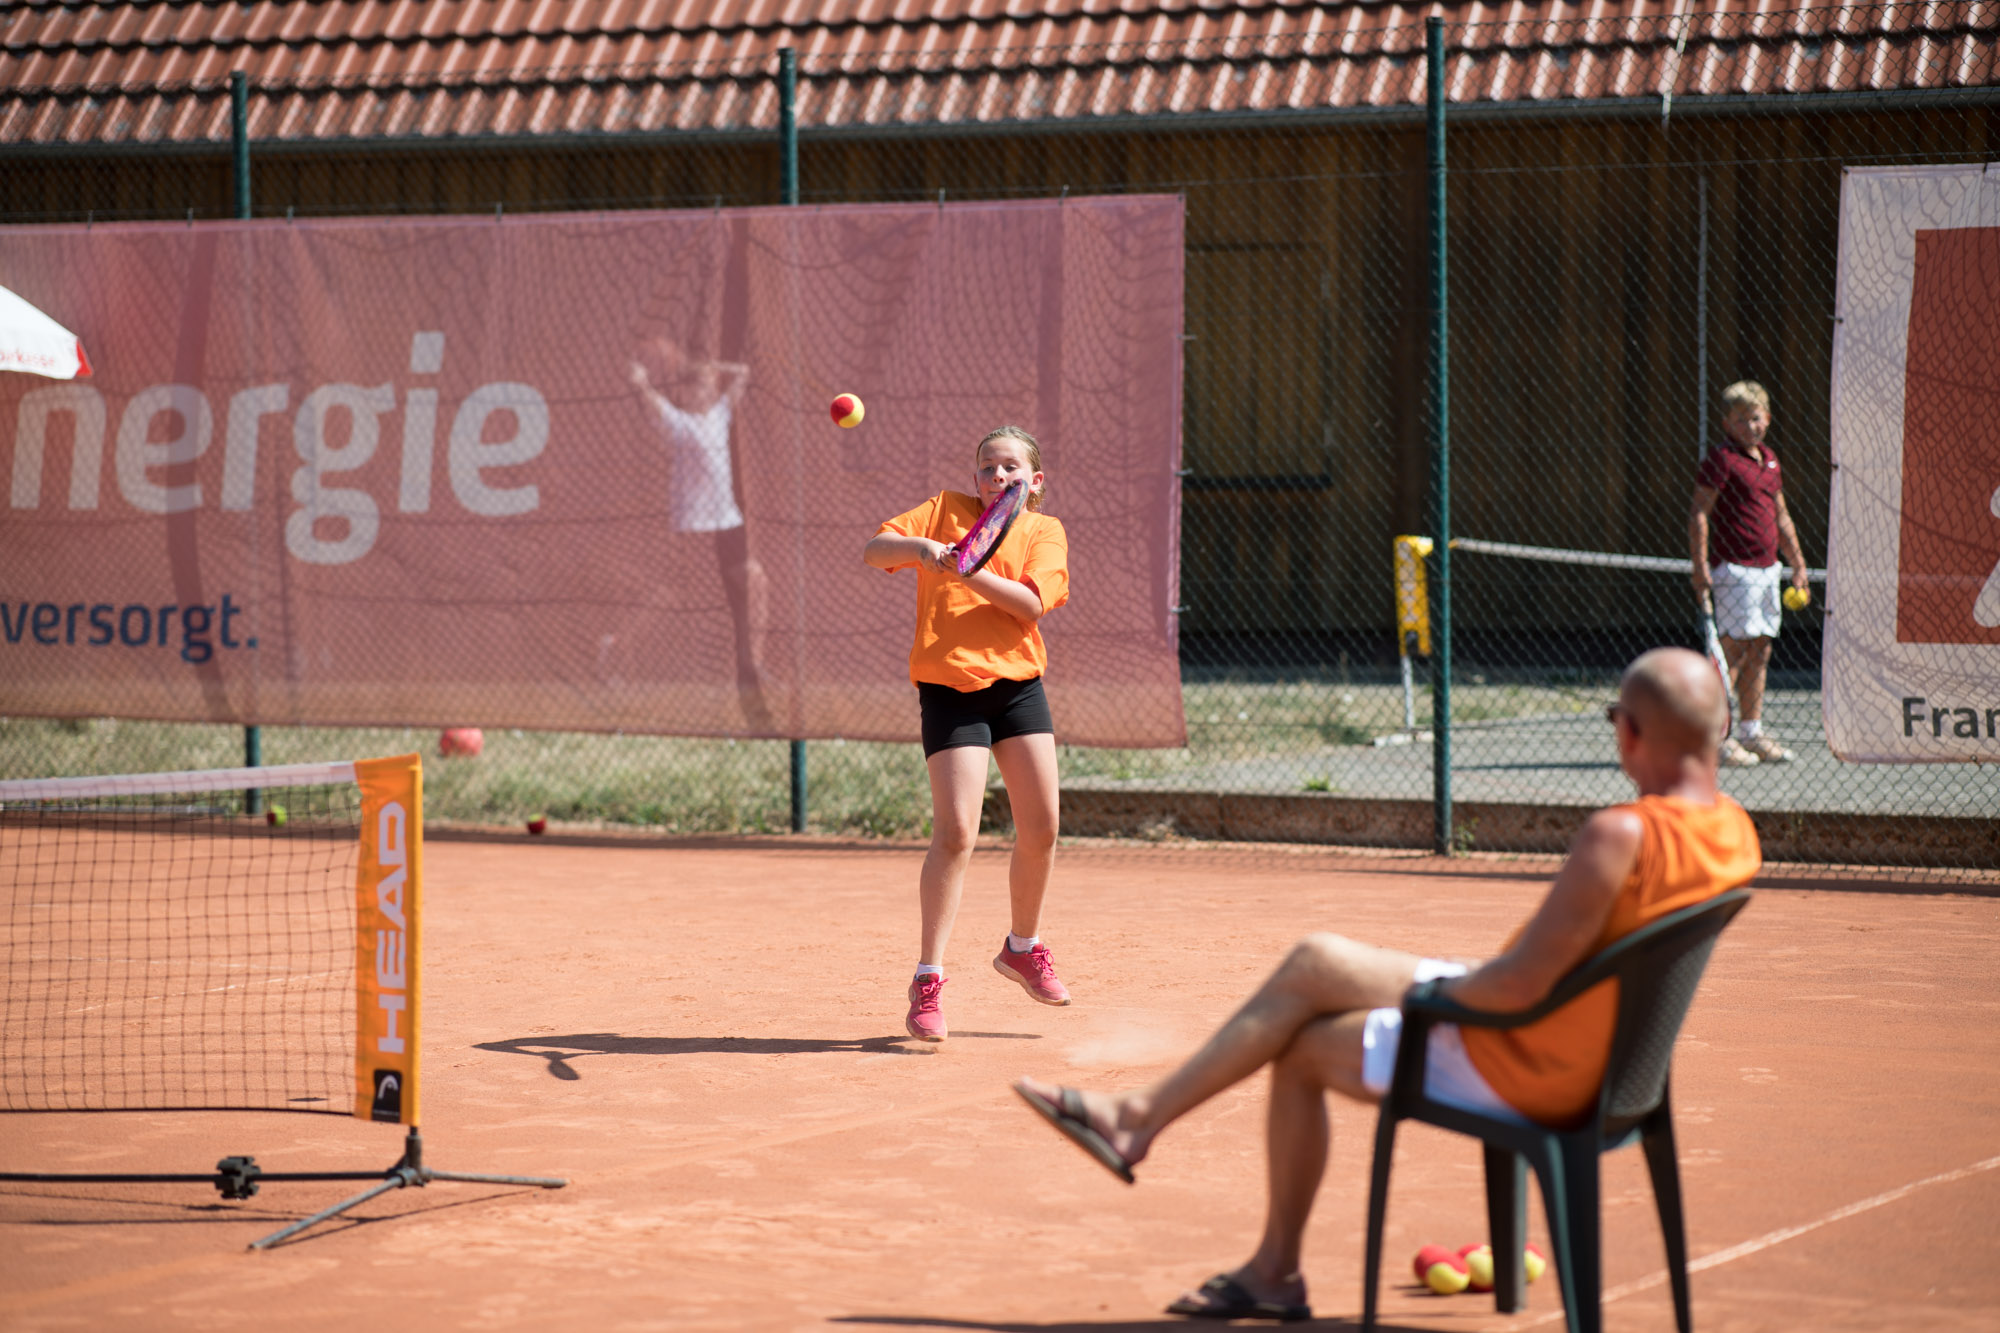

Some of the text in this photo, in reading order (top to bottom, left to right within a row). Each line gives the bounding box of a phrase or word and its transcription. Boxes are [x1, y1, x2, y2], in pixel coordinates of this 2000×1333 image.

[10, 331, 551, 565] nergie
[0, 594, 258, 664] versorgt.
[375, 801, 407, 1054] HEAD
